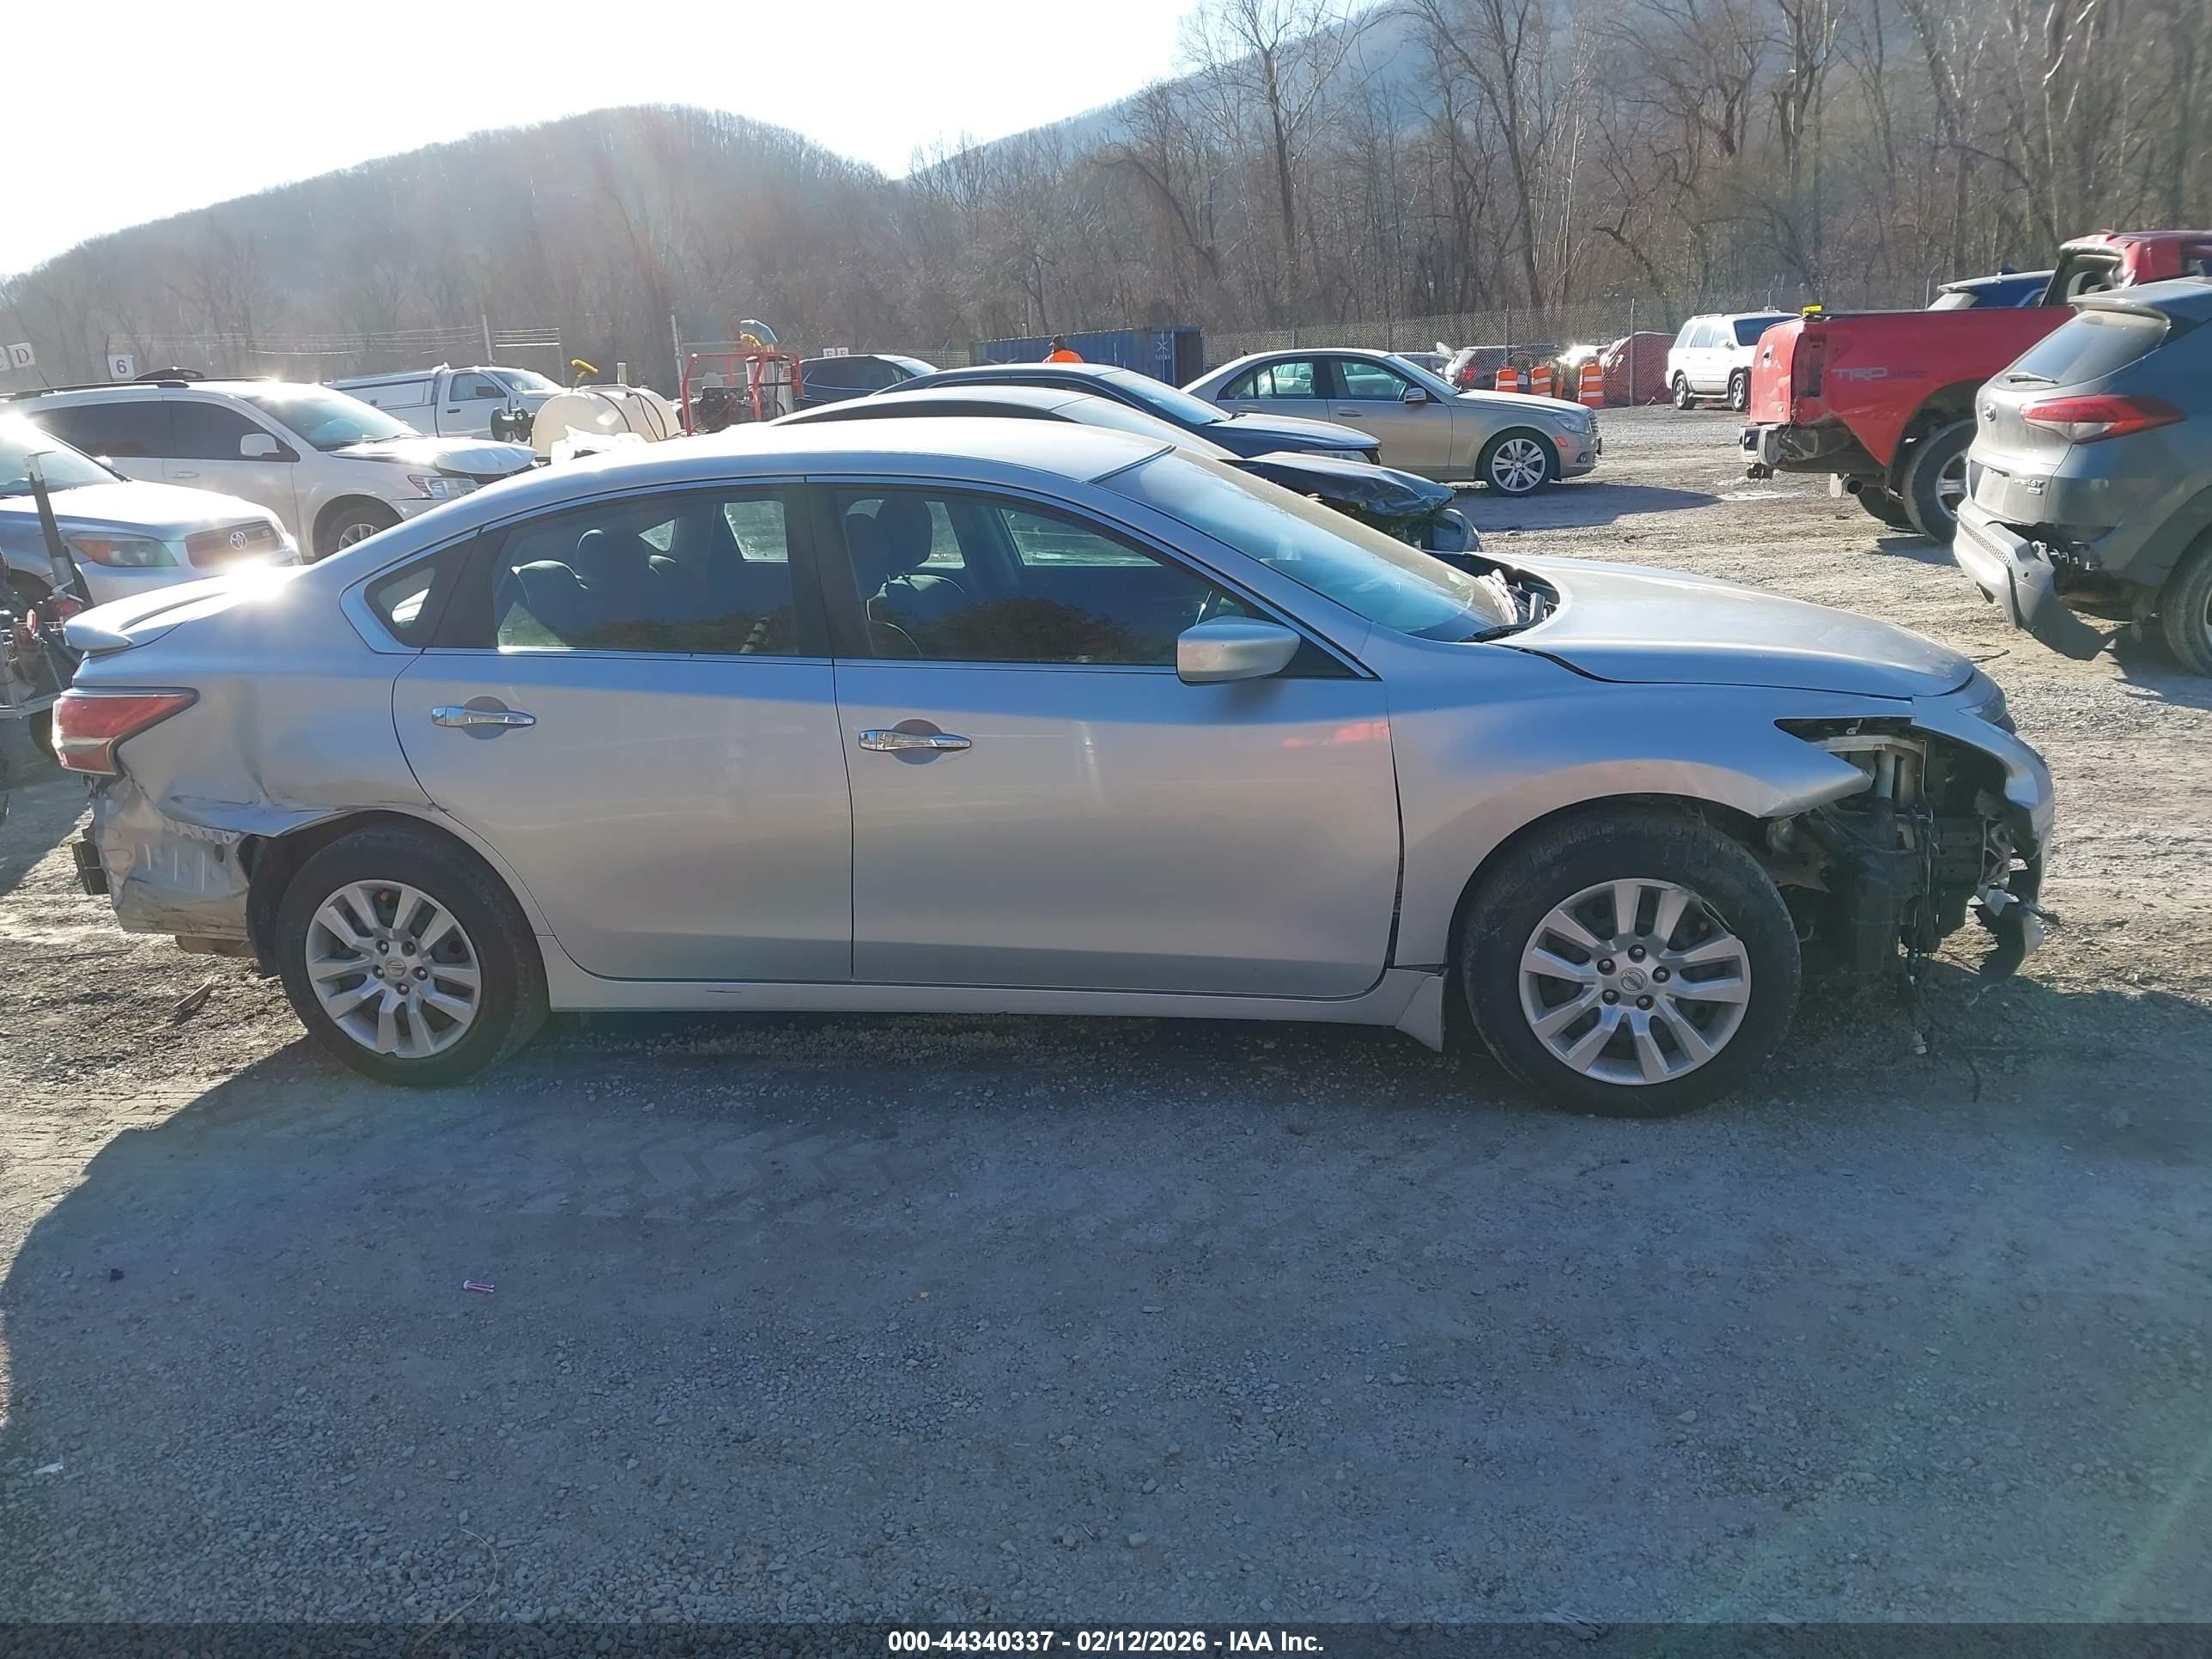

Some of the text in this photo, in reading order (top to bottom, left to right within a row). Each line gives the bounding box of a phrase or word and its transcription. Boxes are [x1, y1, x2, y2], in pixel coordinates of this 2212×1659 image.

[15, 348, 30, 363] D
[115, 359, 127, 374] 6
[1831, 367, 1888, 380] TRD
